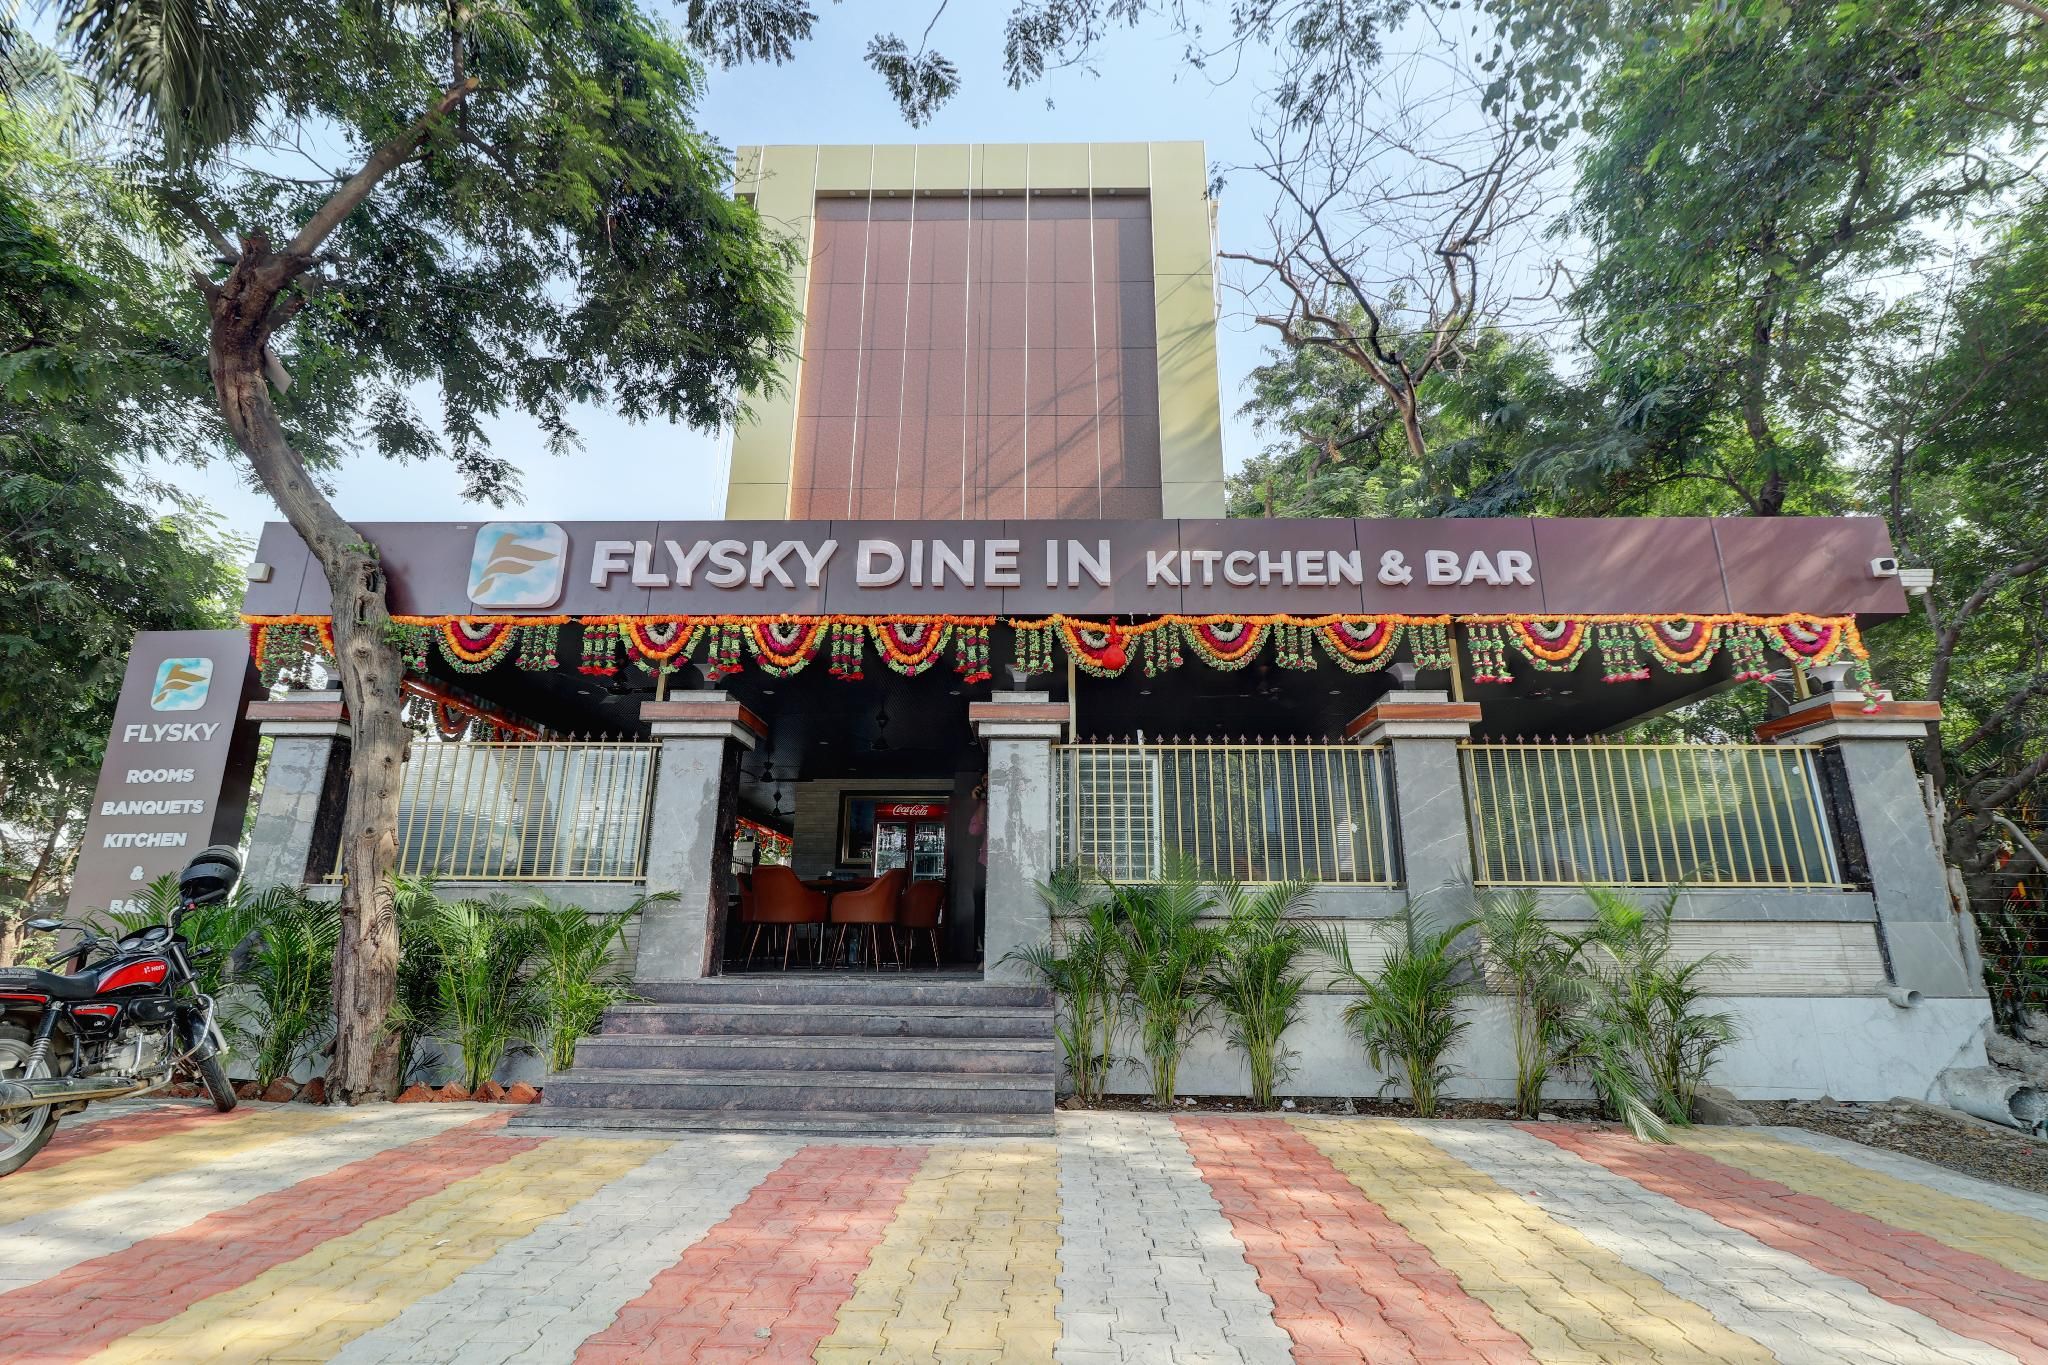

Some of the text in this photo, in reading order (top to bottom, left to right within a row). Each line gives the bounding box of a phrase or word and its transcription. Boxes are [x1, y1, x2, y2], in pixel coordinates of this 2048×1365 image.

[590, 539, 1536, 588] FLYSKY DINE IN KITCHEN & BAR
[122, 722, 220, 743] FLYSKY
[125, 768, 195, 784] ROOMS
[100, 799, 205, 816] BANQUETS
[103, 832, 188, 848] KITCHEN
[129, 865, 145, 881] &
